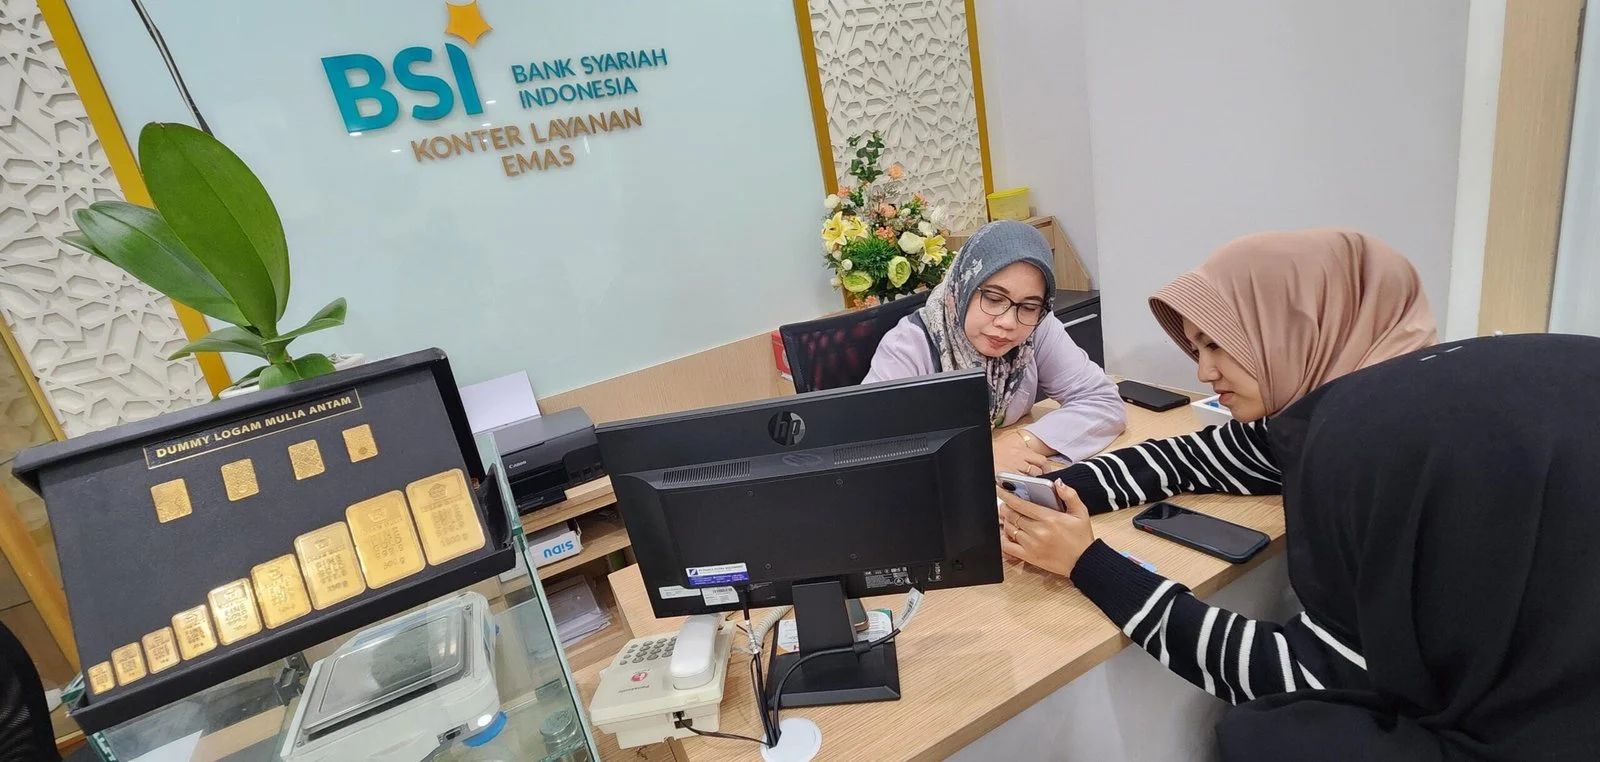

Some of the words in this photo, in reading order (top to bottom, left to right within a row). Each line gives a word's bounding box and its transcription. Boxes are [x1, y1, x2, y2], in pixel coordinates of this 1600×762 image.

[511, 58, 575, 84] BANK
[580, 47, 669, 75] SYARIAH
[321, 42, 484, 133] BSI
[518, 76, 639, 109] INDONESIA
[410, 125, 525, 163] KONTER
[530, 107, 643, 144] LAYANAN
[501, 145, 576, 177] EMAS
[156, 436, 211, 458] DUMMY
[214, 421, 262, 442] LOGAM
[264, 409, 306, 427] MULIA
[308, 396, 352, 415] ANTAM
[769, 411, 805, 447] hp
[509, 460, 527, 469] Canon
[543, 540, 574, 558] SiDU
